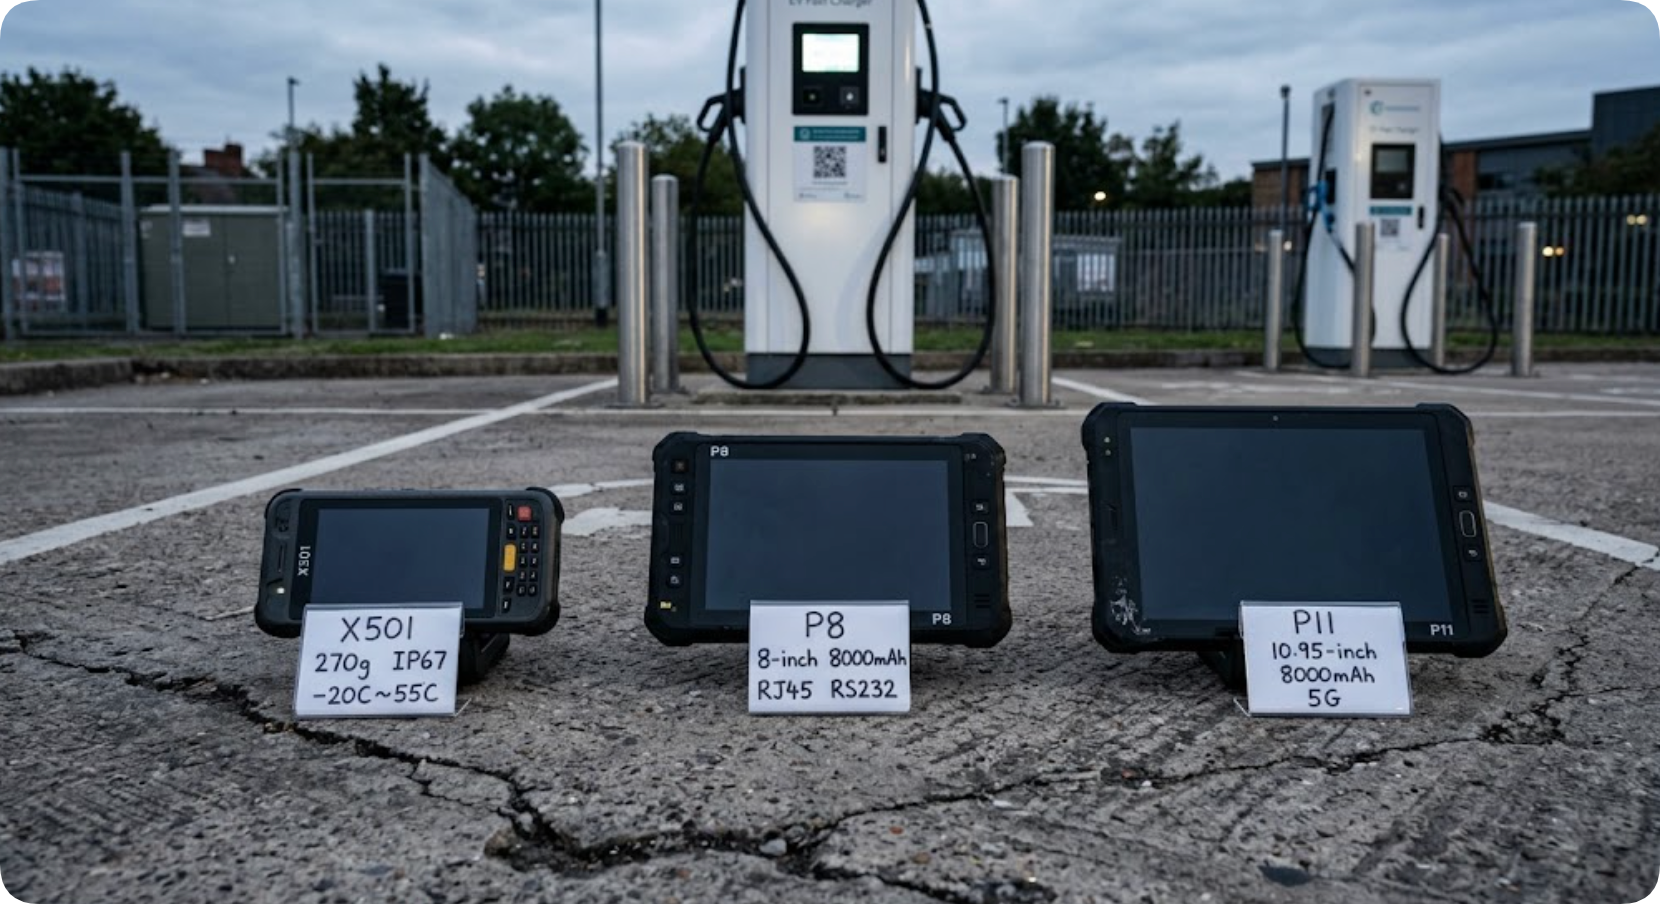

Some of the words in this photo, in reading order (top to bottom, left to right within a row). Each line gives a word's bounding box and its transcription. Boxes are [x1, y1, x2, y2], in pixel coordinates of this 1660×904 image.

[710, 445, 730, 458] P8
[297, 545, 311, 576] X501
[340, 615, 413, 642] X501
[805, 611, 845, 639] P8
[932, 612, 952, 626] P8
[1429, 623, 1454, 636] P11
[757, 648, 818, 669] 8-inch
[829, 647, 907, 668] 8000mAh
[1272, 641, 1378, 660] 10.95-inch
[314, 652, 371, 680] 270g
[392, 650, 448, 671] IP67
[1279, 665, 1376, 684] 8000mAh
[757, 679, 814, 701] RJ45
[830, 679, 898, 699] RS232
[1308, 688, 1342, 707] 5G
